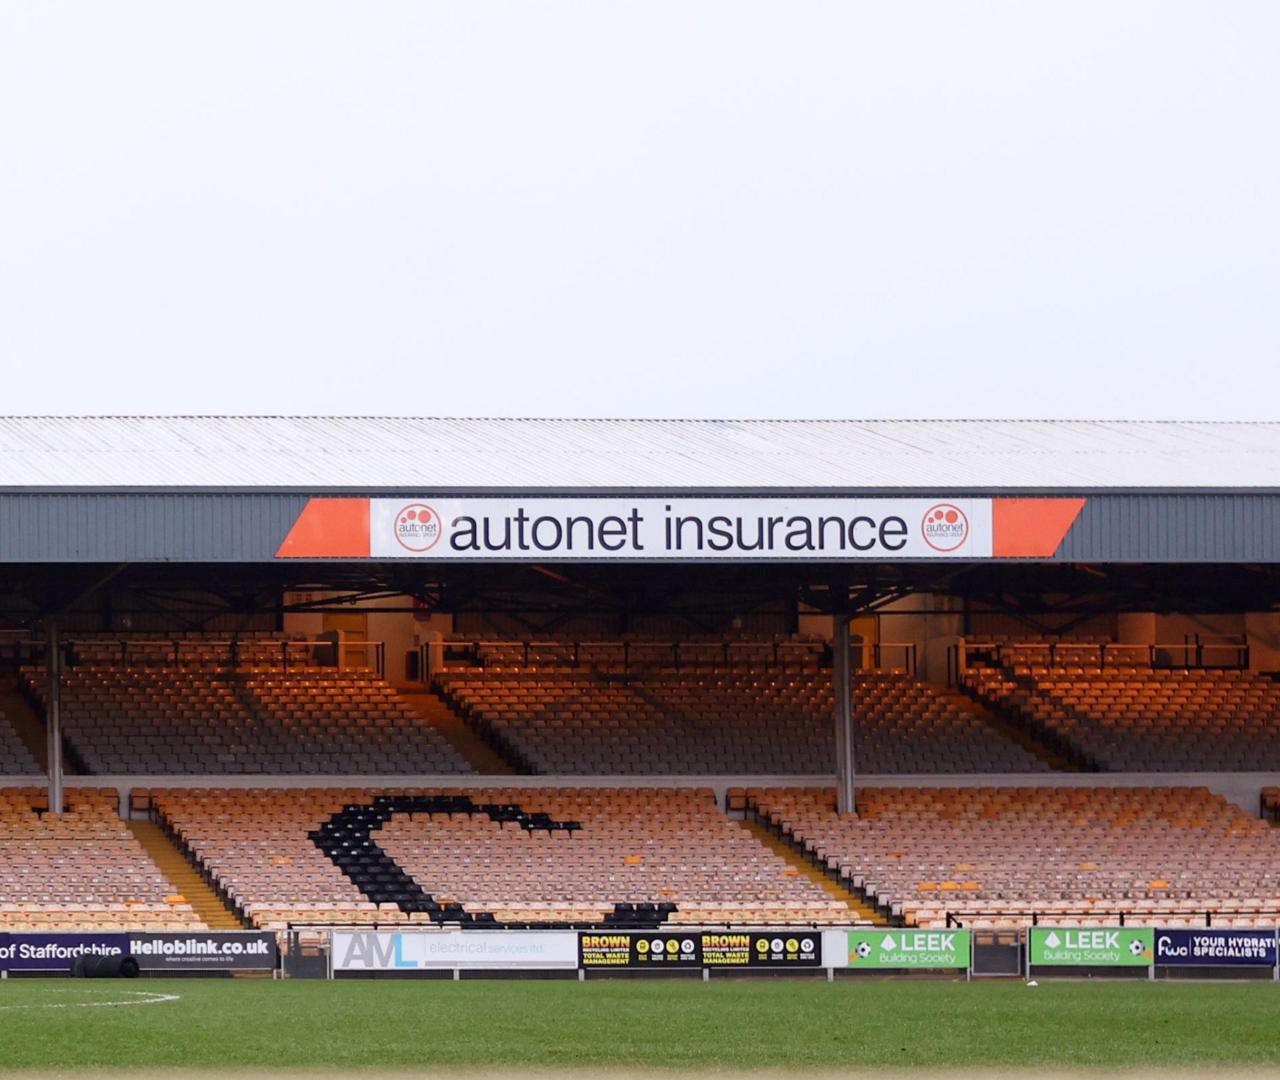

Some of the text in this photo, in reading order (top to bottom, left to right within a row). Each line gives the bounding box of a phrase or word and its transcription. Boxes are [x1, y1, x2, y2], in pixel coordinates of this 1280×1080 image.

[399, 523, 436, 532] autonet
[448, 504, 909, 552] autonet insurance
[926, 523, 963, 532] autonet
[308, 796, 678, 932] C
[130, 938, 269, 955] Helloblink.co.uk
[582, 936, 630, 948] BROWN
[702, 935, 750, 947] BROWN
[900, 933, 955, 951] LEEK
[1064, 931, 1120, 949] LEEK
[1193, 936, 1276, 949] YOUR HYDRATI
[19, 943, 122, 960] Staffordshire
[342, 934, 418, 968] AML
[429, 941, 487, 953] electrical
[1193, 946, 1266, 957] SPECIALISTS
[879, 952, 955, 964] Building Society
[1043, 949, 1120, 962] Building Society
